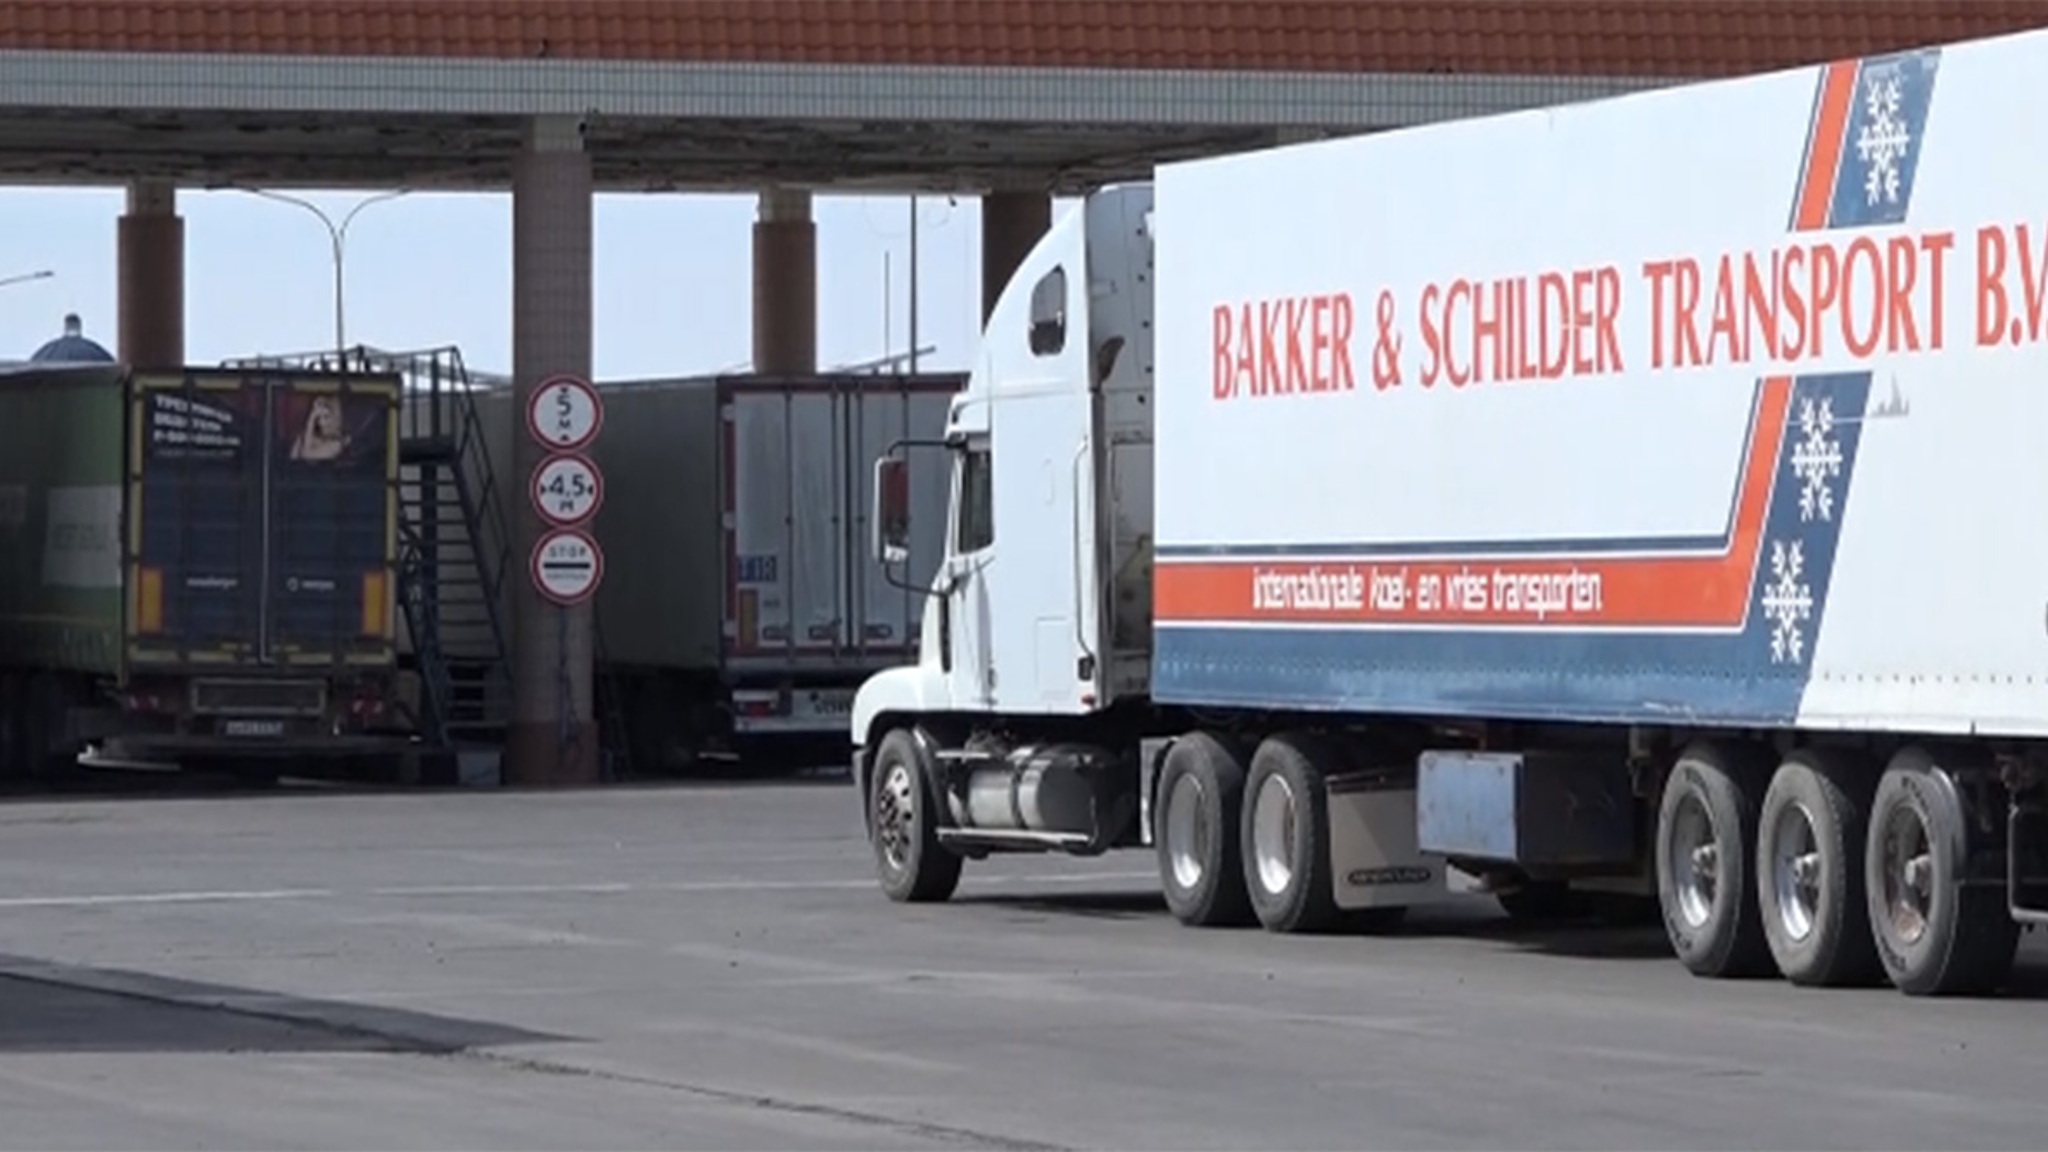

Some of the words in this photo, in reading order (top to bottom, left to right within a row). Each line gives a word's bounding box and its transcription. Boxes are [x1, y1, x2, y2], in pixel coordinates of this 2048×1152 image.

[1213, 294, 1354, 400] BAKKER
[1372, 290, 1402, 391] &
[1420, 265, 1624, 388] SCHILDER
[1643, 232, 1954, 369] TRANSPORT
[556, 394, 572, 417] 5
[549, 474, 585, 498] 4,5
[549, 545, 587, 558] STOP
[1253, 566, 1363, 609] internationale
[1417, 573, 1440, 610] en
[1446, 565, 1486, 611] vries
[1492, 566, 1602, 620] transporten
